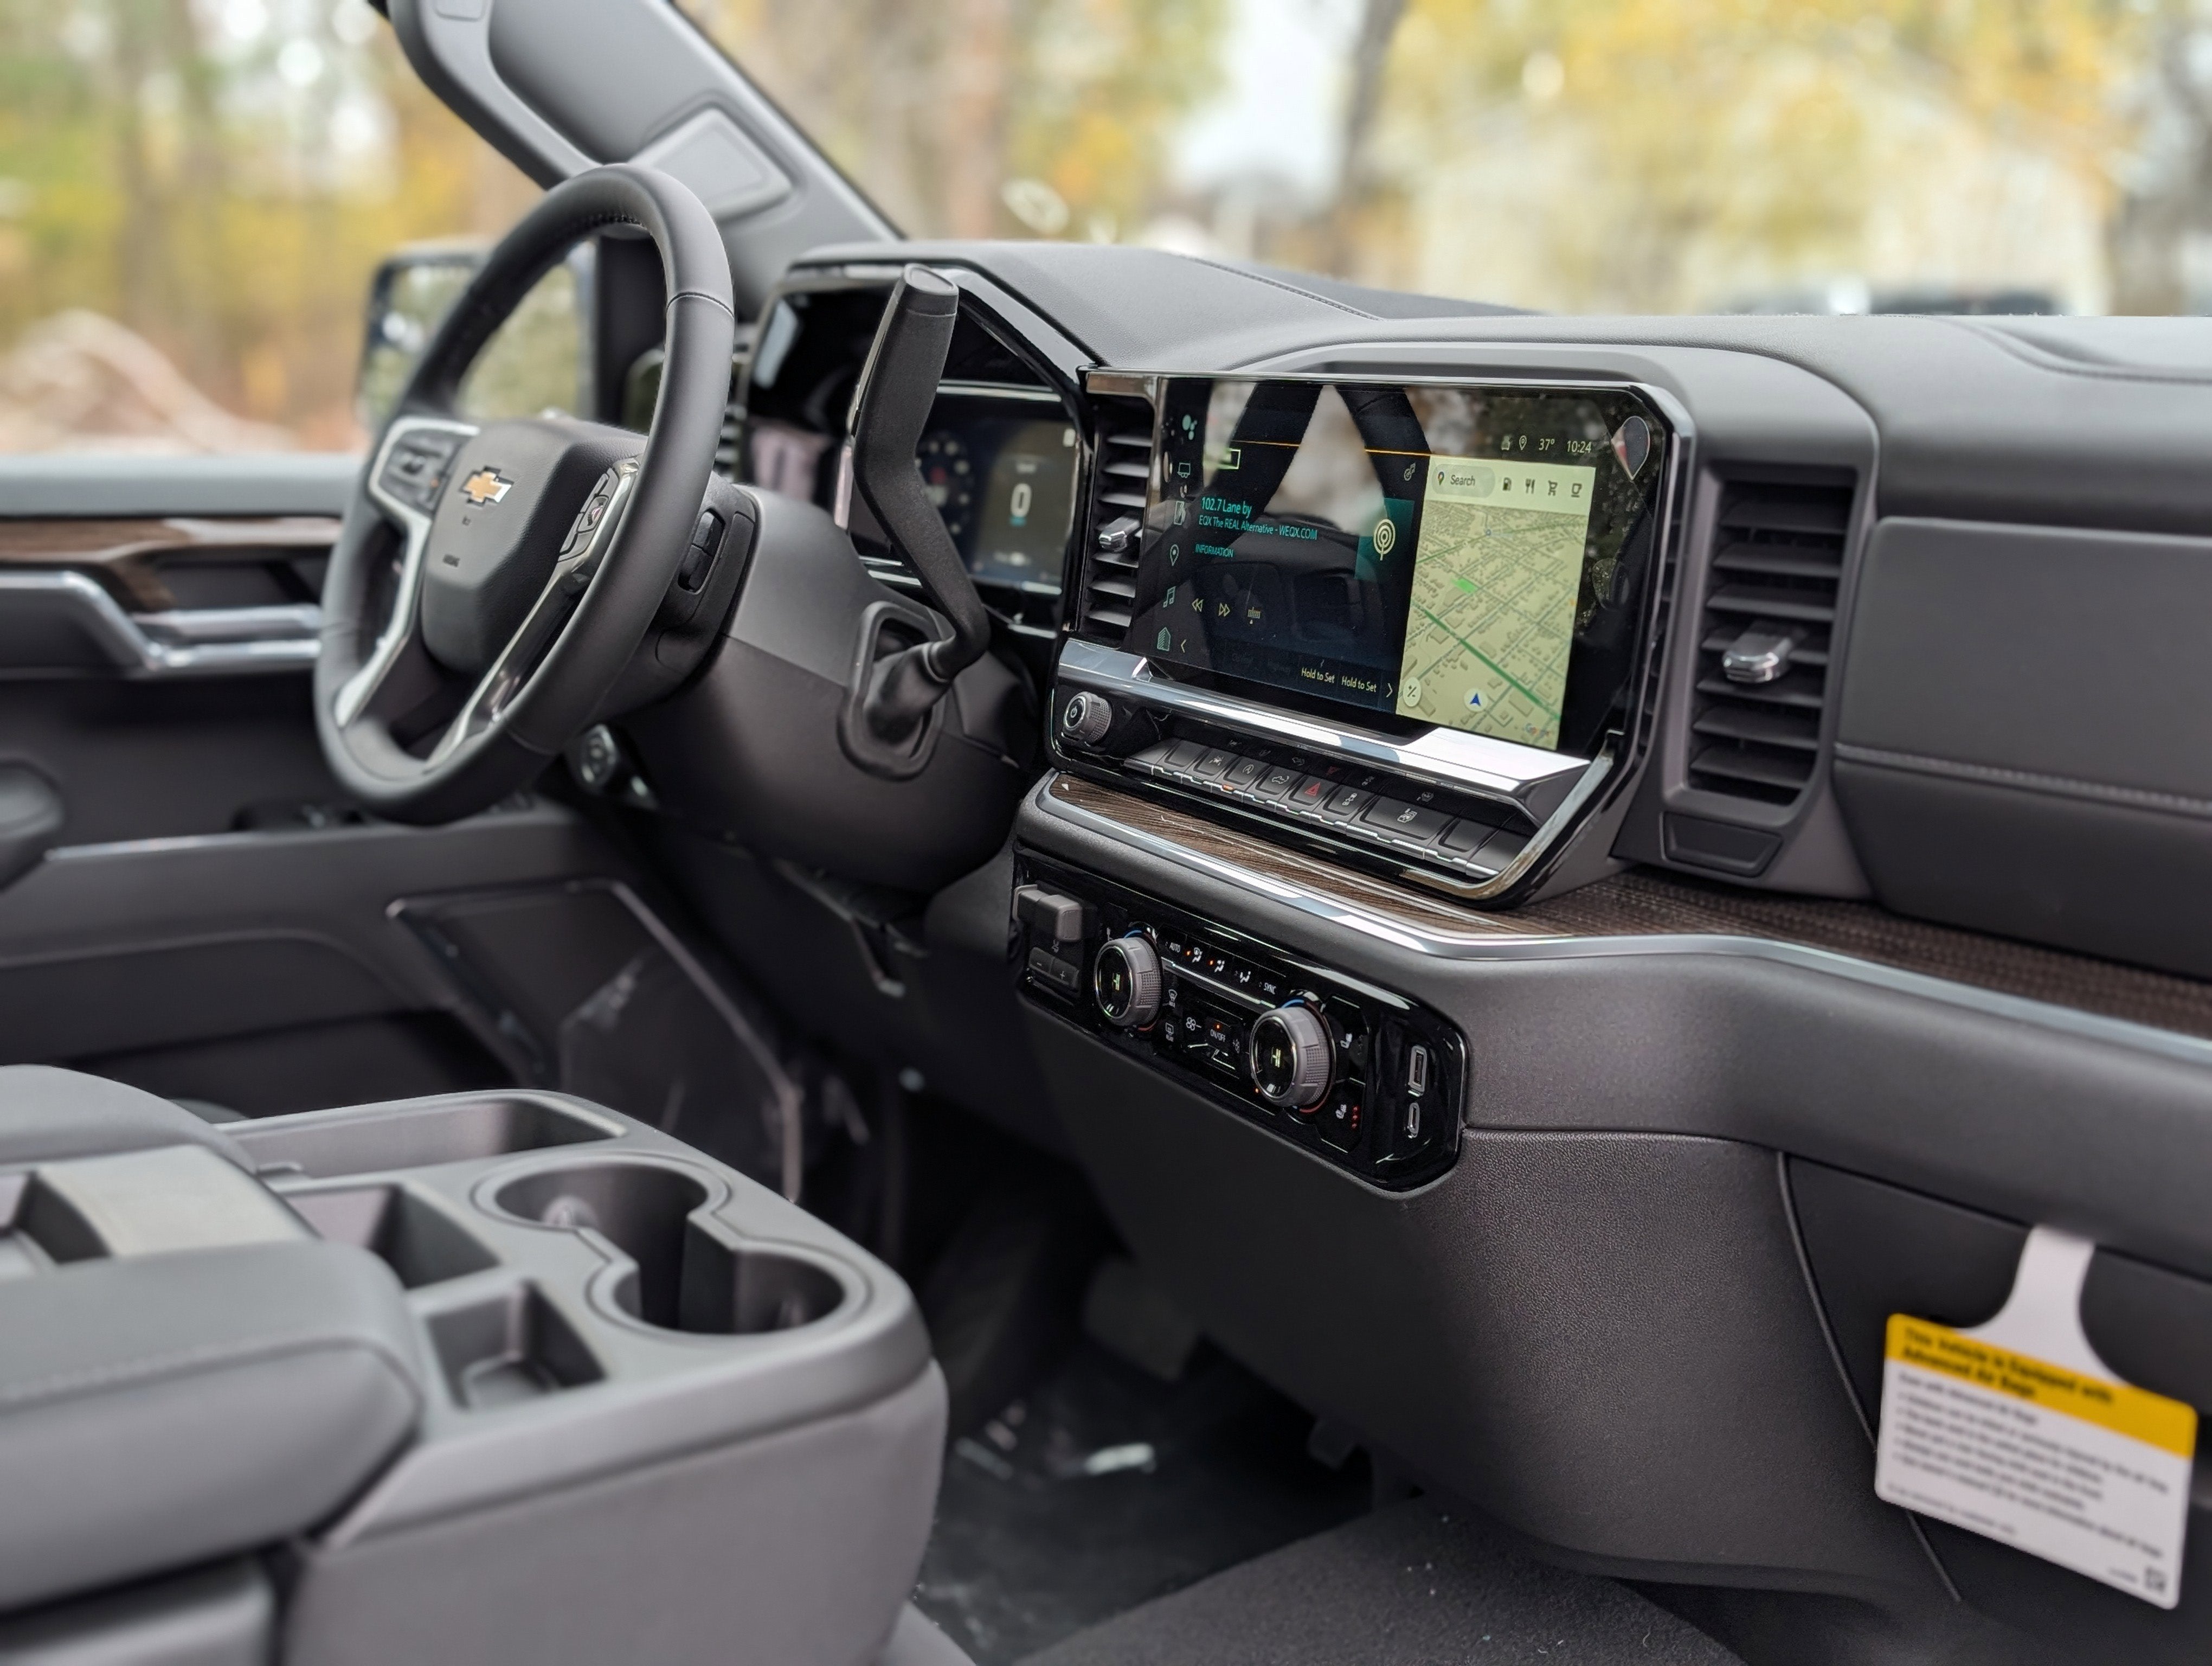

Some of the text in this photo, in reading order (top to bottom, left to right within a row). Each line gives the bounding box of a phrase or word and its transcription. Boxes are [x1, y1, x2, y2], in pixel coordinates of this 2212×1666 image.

[1567, 440, 1592, 453] 10:24
[1450, 475, 1476, 486] Search
[1201, 497, 1252, 518] 102.7 Lane by
[1199, 515, 1212, 526] EQX
[1213, 516, 1224, 528] The
[1224, 518, 1239, 530] REAL
[1241, 521, 1274, 534] Alternative
[1279, 525, 1318, 540] WEQX.COM
[1195, 544, 1233, 558] INFORMATION
[1301, 668, 1335, 684] Hold to Set
[1341, 676, 1377, 693] Hold to Set
[1169, 942, 1181, 953] AUTO
